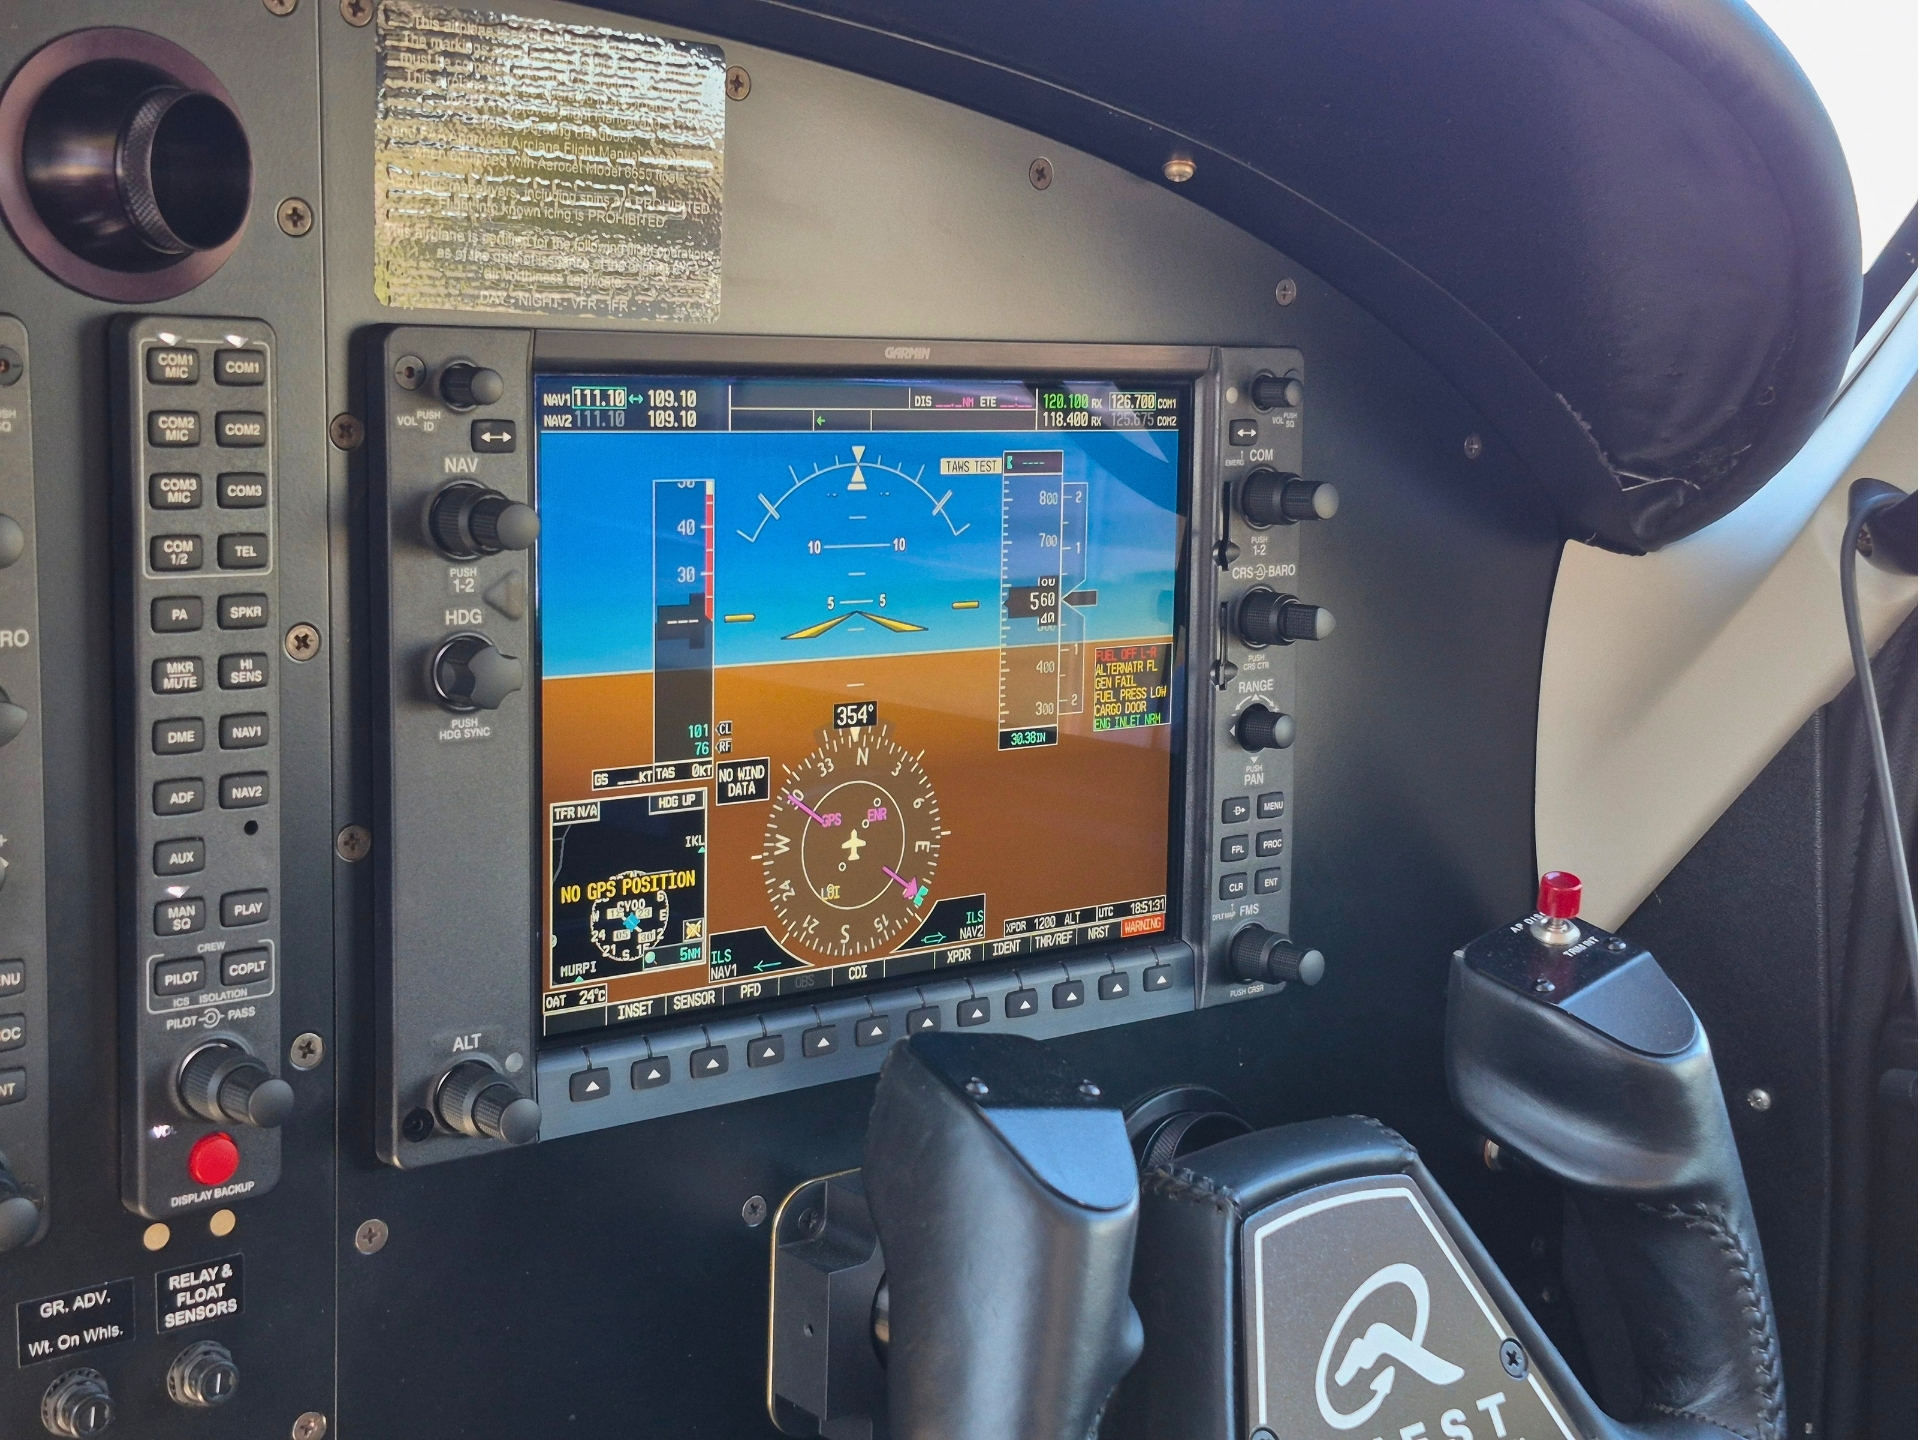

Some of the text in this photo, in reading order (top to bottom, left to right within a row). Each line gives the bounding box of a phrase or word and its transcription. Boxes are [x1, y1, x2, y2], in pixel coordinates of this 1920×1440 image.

[571, 297, 597, 311] VFR
[158, 353, 193, 366] COM1
[885, 346, 930, 360] GARMIN
[165, 366, 189, 379] MIC
[225, 361, 260, 374] COM1
[543, 389, 697, 408] NAV1 111.10 109.10
[1043, 393, 1176, 409] 120.100 126.700 COM1
[158, 417, 195, 429] COM2
[397, 416, 418, 427] VOL
[417, 411, 441, 421] PUSH
[543, 410, 697, 428] NAV2 111.10 109.10
[1043, 411, 1177, 428] 118.400 125.675 COM2
[225, 424, 260, 436] COM2
[423, 420, 434, 432] ID
[165, 430, 189, 442] MIC
[1249, 448, 1274, 462] COM
[444, 457, 478, 474] NAV
[946, 460, 997, 473] TAWS TEST
[160, 479, 197, 491] COM3
[227, 485, 262, 497] COM3
[168, 491, 191, 503] MIC
[1039, 491, 1058, 505] 800
[677, 519, 696, 535] 40
[163, 540, 193, 553] COM
[1038, 533, 1057, 548] 700
[235, 545, 257, 557] TEL
[170, 553, 188, 565] 1/2
[449, 567, 477, 579] PUSH
[677, 566, 696, 582] 30
[1232, 564, 1296, 580] CRS BARO
[452, 578, 475, 594] 1-2
[1029, 592, 1055, 611] 560
[172, 609, 188, 621] PA
[230, 606, 262, 618] SPKR
[445, 609, 483, 626] HDG
[1095, 646, 1157, 663] FUEL OFF L-R
[167, 661, 194, 673] MKR
[240, 658, 253, 670] HI
[1036, 660, 1055, 674] 400
[1095, 660, 1158, 677] ALTERNATR FL
[164, 676, 198, 689] MUTE
[230, 670, 263, 683] SENS
[1095, 675, 1137, 690] GEN FAIL
[1238, 679, 1274, 694] RANGE
[1094, 685, 1167, 703] FUEL PRESS LOW
[837, 704, 874, 726] 354°
[1035, 702, 1054, 716] 300
[1094, 701, 1147, 716] CARGO DOOR
[450, 718, 479, 730] PUSH
[1094, 712, 1161, 730] ENG INLET NRM
[168, 731, 195, 744] DME
[232, 726, 262, 739] NAV1
[439, 726, 490, 741] HDG SYNC
[656, 767, 676, 779] TAS
[718, 765, 765, 782] NO WIND
[1244, 773, 1264, 786] PAN
[231, 786, 263, 799] NAV2
[728, 782, 756, 797] DATA
[169, 792, 195, 804] ADF
[659, 794, 696, 808] HDG UP
[554, 805, 598, 820] TFR N/A
[1263, 801, 1283, 812] MENU
[1231, 844, 1245, 855] FPL
[1263, 838, 1282, 850] PROC
[169, 851, 195, 864] AUX
[560, 870, 696, 904] NO GPS POSITION
[1229, 882, 1244, 893] CLR
[1264, 877, 1278, 888] ENT
[168, 905, 196, 918] MAN
[234, 902, 263, 916] PLAY
[1098, 898, 1165, 919] UTC 18:51:31
[1240, 903, 1259, 917] FMS
[965, 910, 984, 924] ILS
[1005, 911, 1081, 933] XPDR 1200 ALT
[172, 918, 191, 931] SQ
[959, 924, 984, 940] NAV2
[197, 941, 226, 954] CREW
[680, 947, 701, 961] 5NM
[711, 949, 732, 964] ILS
[229, 960, 266, 977] COPLT
[560, 961, 597, 977] MURPI
[617, 917, 1162, 1020] INSET SENSOR PFD CDI XPDR IDENT TMR/REF NRST WARNING
[711, 963, 737, 980] NAV1
[164, 971, 199, 986] PILOT
[172, 988, 248, 1008] ICS ISOLATION
[546, 989, 606, 1009] OAT 24°C
[166, 1006, 256, 1030] PILOT PASS
[452, 1033, 482, 1053] ALT
[171, 1180, 255, 1208] DISPLAY BACKUP
[168, 1263, 233, 1291] RELAY &
[176, 1282, 227, 1308] FLOAT
[40, 1290, 111, 1319] GR. ADV.
[164, 1298, 238, 1329] SENSORS
[28, 1323, 124, 1358] Wt. On Whls.
